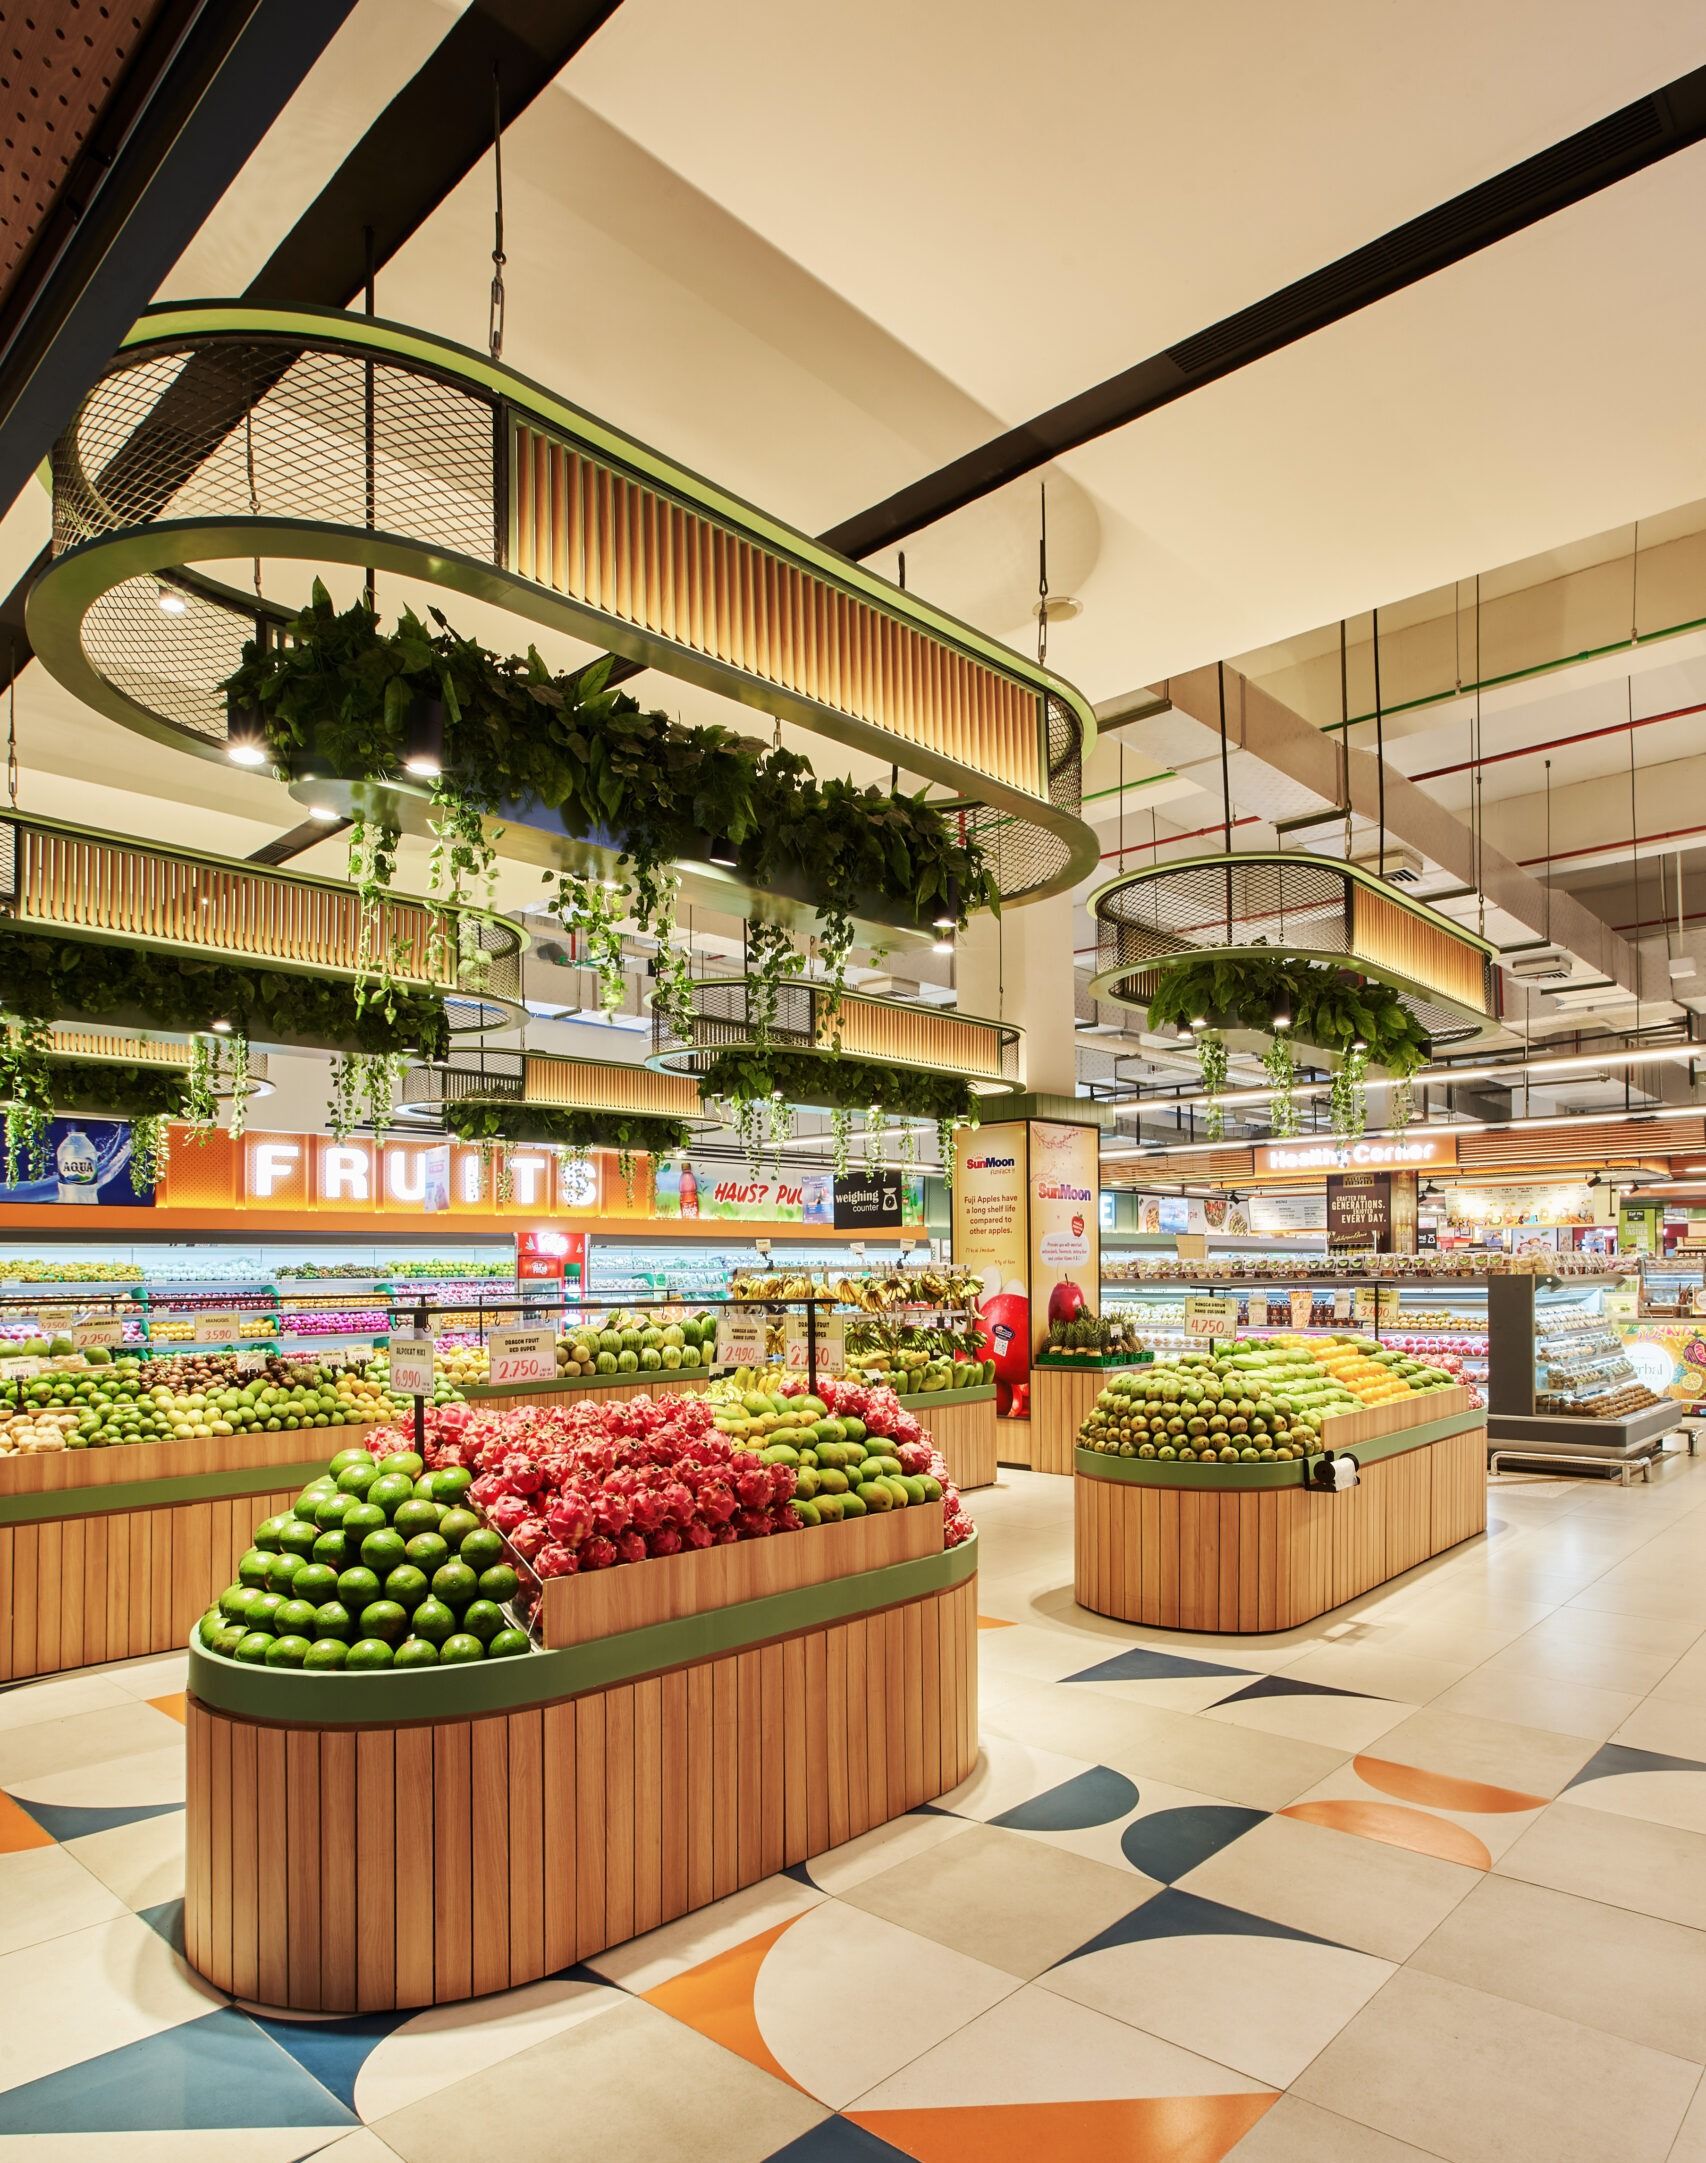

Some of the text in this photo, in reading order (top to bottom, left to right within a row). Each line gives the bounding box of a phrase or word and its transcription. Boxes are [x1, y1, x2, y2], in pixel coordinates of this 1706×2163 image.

[1269, 1143, 1434, 1169] Healthy Corner
[63, 1161, 93, 1173] AQUA
[966, 1157, 1015, 1169] SunMoon
[255, 1144, 597, 1206] FRUITS
[714, 1182, 770, 1203] HAUS?
[835, 1190, 879, 1204] weighing
[1038, 1183, 1091, 1201] SunMoon
[964, 1194, 1018, 1205] Fuji Apples have
[1331, 1200, 1386, 1210] GENERATIONS.
[852, 1204, 879, 1212] counter
[971, 1206, 986, 1214] long
[987, 1205, 1003, 1213] shelf
[1004, 1204, 1016, 1212] life
[970, 1216, 1003, 1225] compared
[1341, 1213, 1387, 1224] EVERY DAY.
[988, 1227, 1013, 1235] apples.
[1191, 1319, 1225, 1334] 4.750
[80, 1333, 111, 1345] 2.250
[206, 1330, 231, 1340] 3.590
[725, 1346, 754, 1362] 2.490
[499, 1360, 539, 1379] 2.750
[395, 1369, 421, 1388] 6.990
